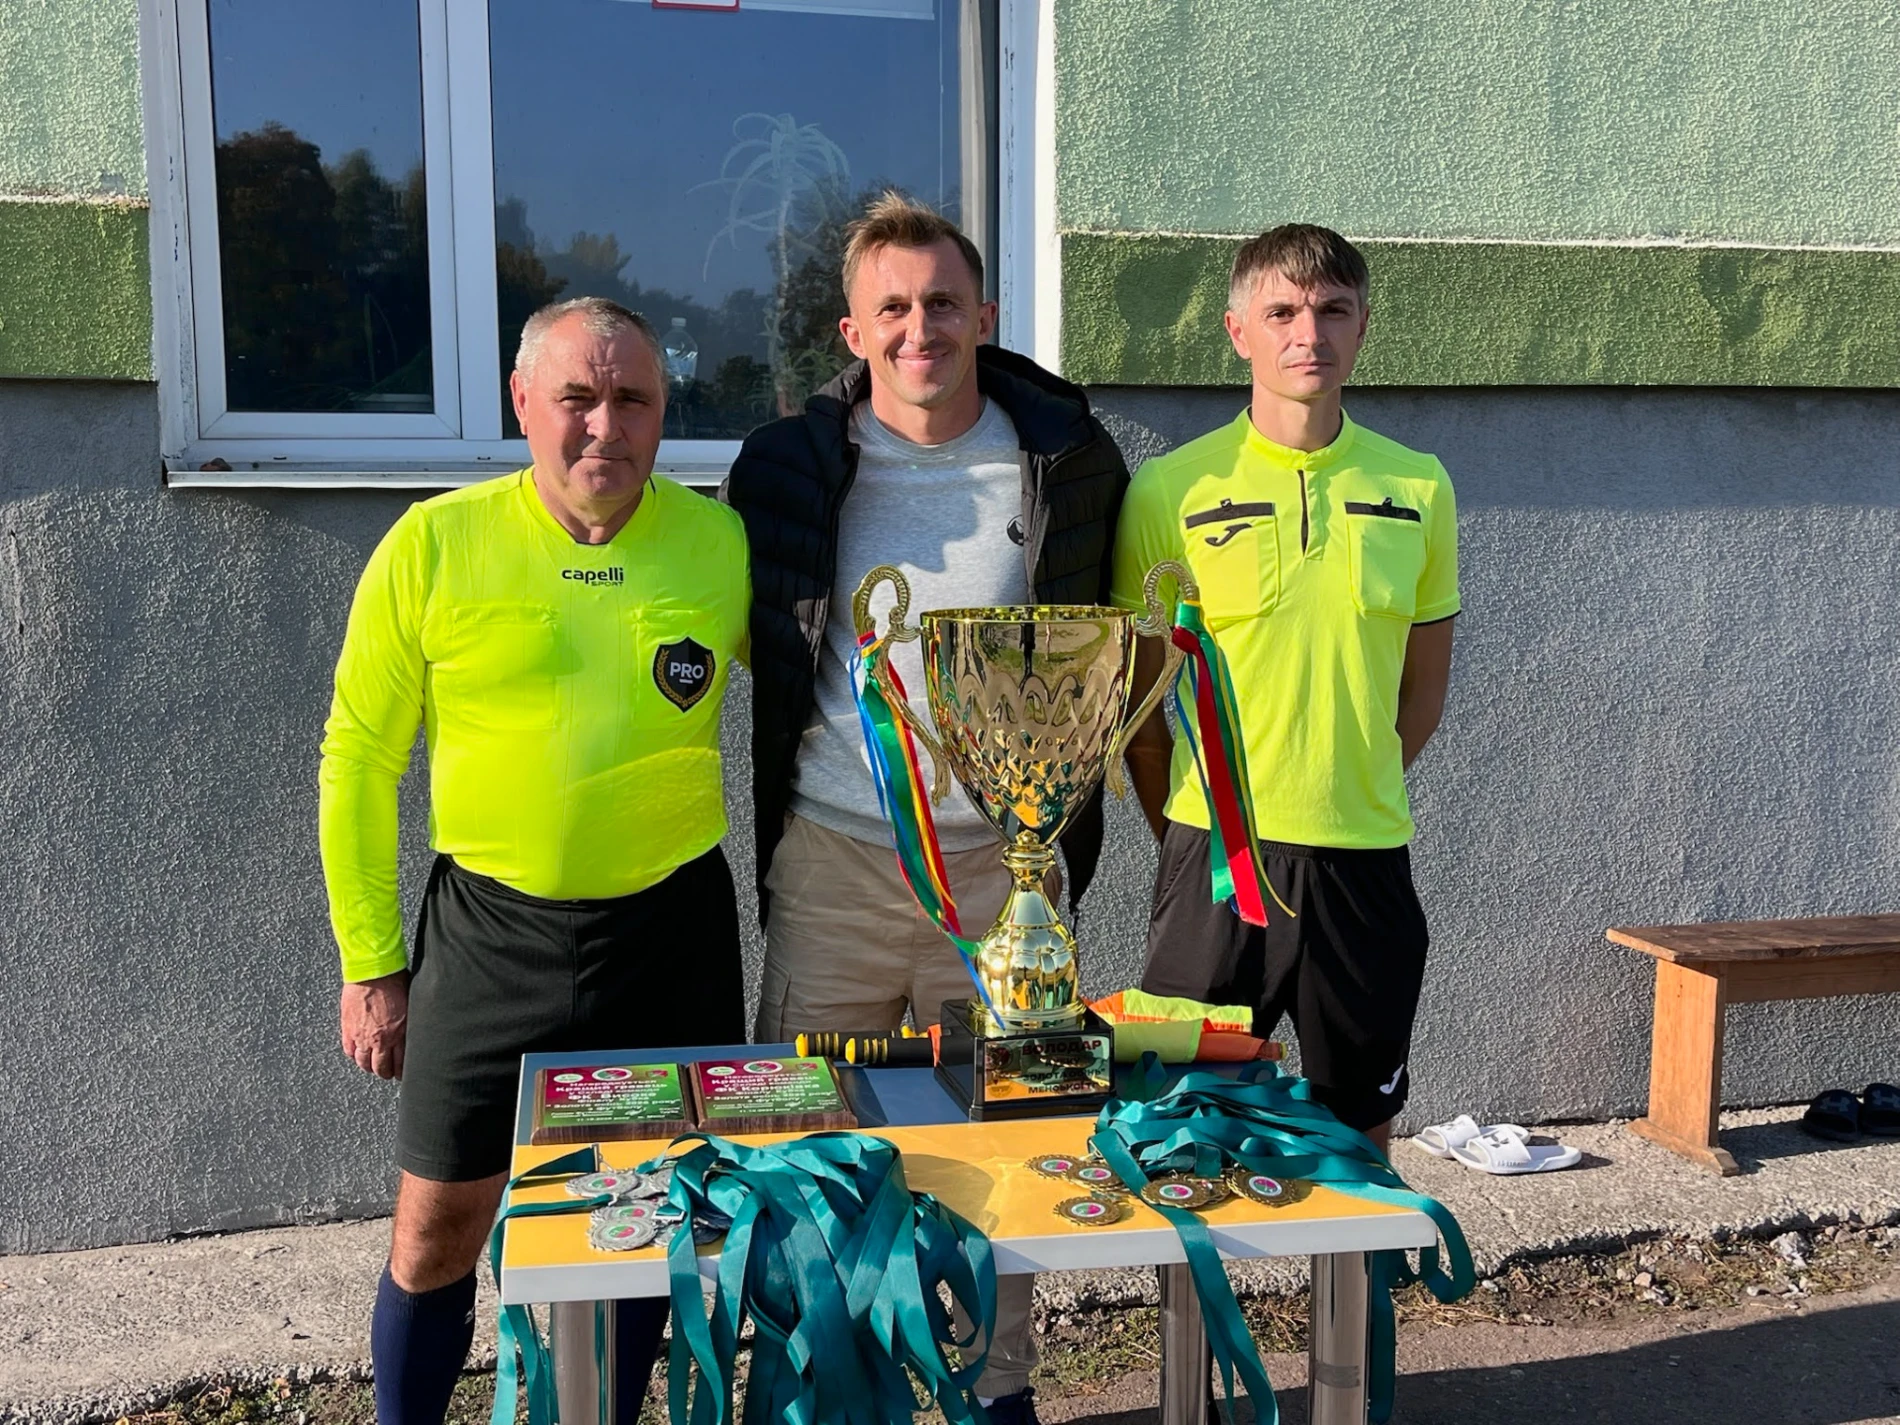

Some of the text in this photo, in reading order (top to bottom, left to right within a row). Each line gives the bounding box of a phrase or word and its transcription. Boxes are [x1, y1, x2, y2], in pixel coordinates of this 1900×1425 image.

[562, 567, 624, 584] capelli
[670, 661, 704, 680] PRO
[1022, 1040, 1102, 1055] ВОЛОДАР
